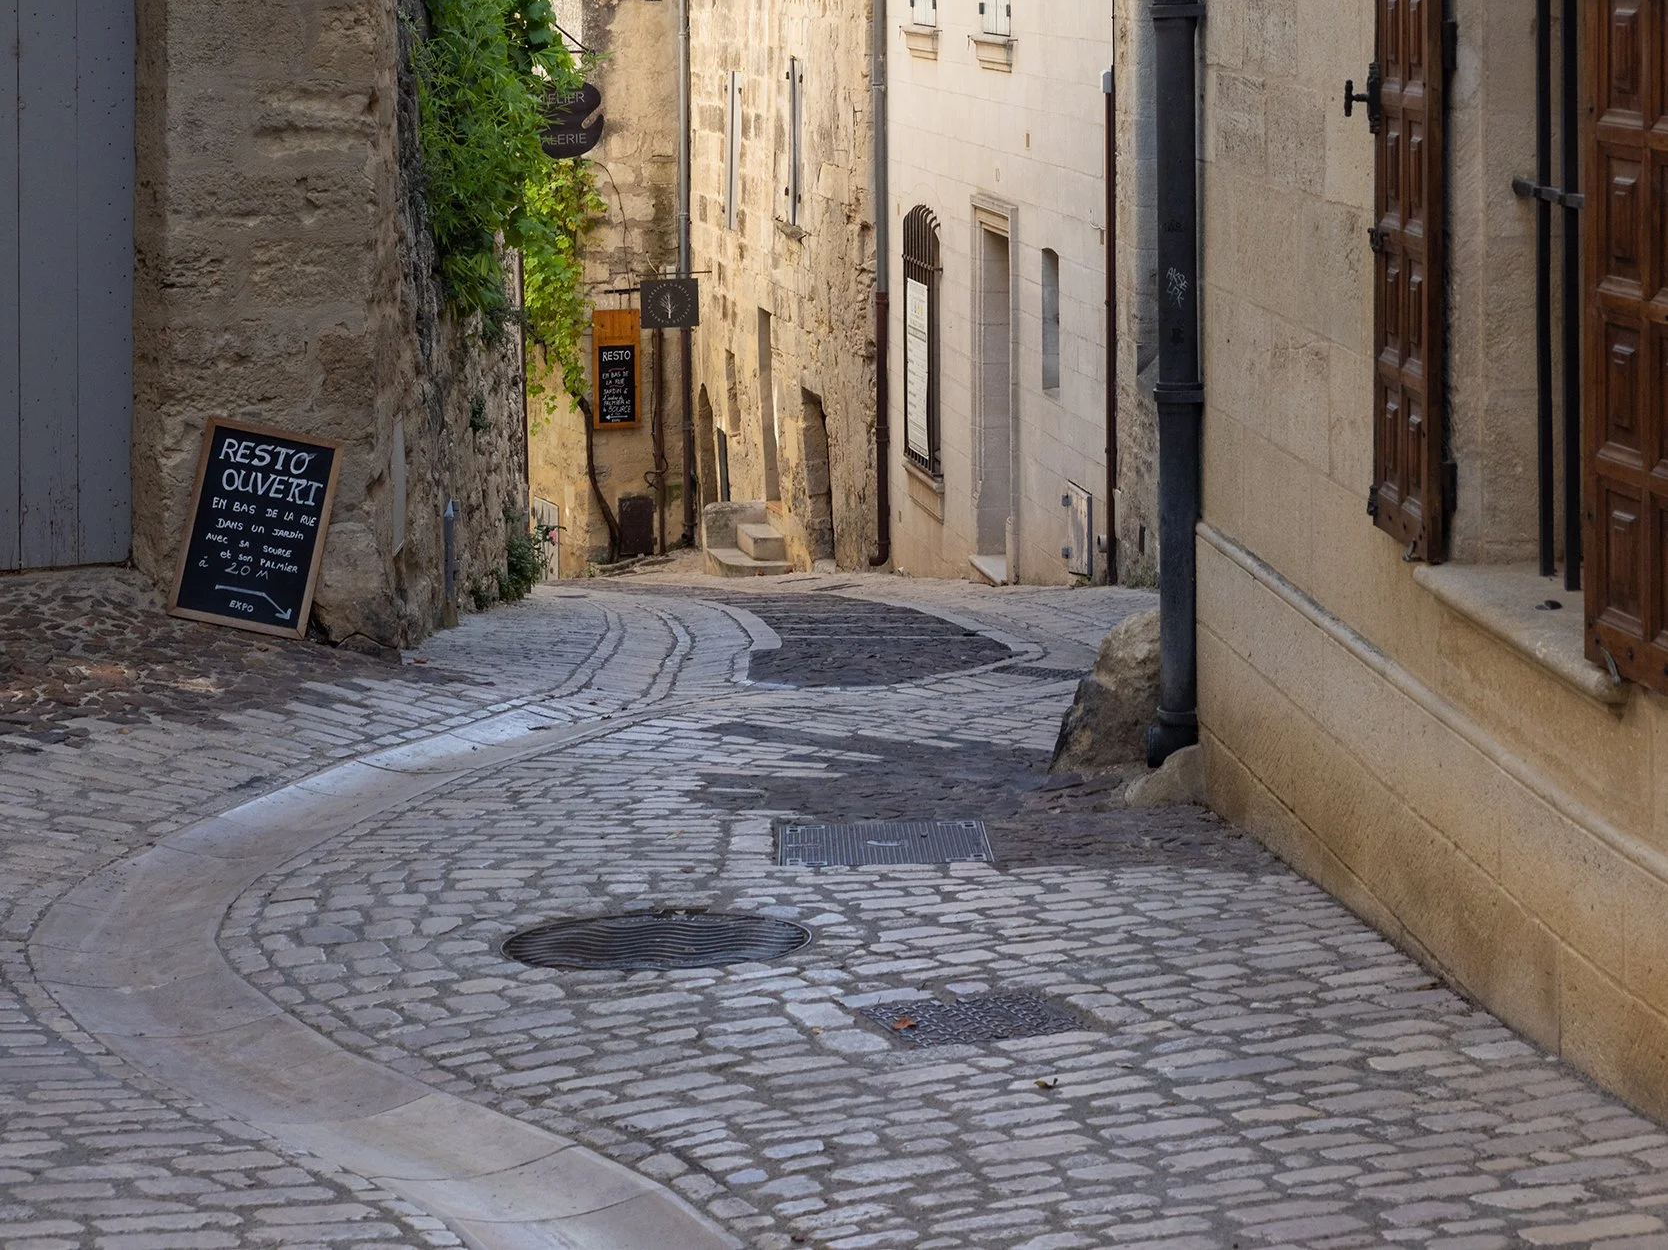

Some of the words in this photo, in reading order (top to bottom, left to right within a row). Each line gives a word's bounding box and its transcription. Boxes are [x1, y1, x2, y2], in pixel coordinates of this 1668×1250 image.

[602, 350, 631, 361] RESTO
[221, 468, 324, 506] OUVERT
[212, 496, 227, 510] EN
[232, 501, 257, 515] BAS
[265, 508, 279, 518] DE
[283, 511, 294, 521] LA
[300, 514, 317, 527] RUE
[215, 518, 244, 531] DANS
[220, 550, 231, 559] et
[262, 545, 293, 558] SOURCE
[224, 562, 251, 576] 20
[229, 600, 254, 613] EXPO
